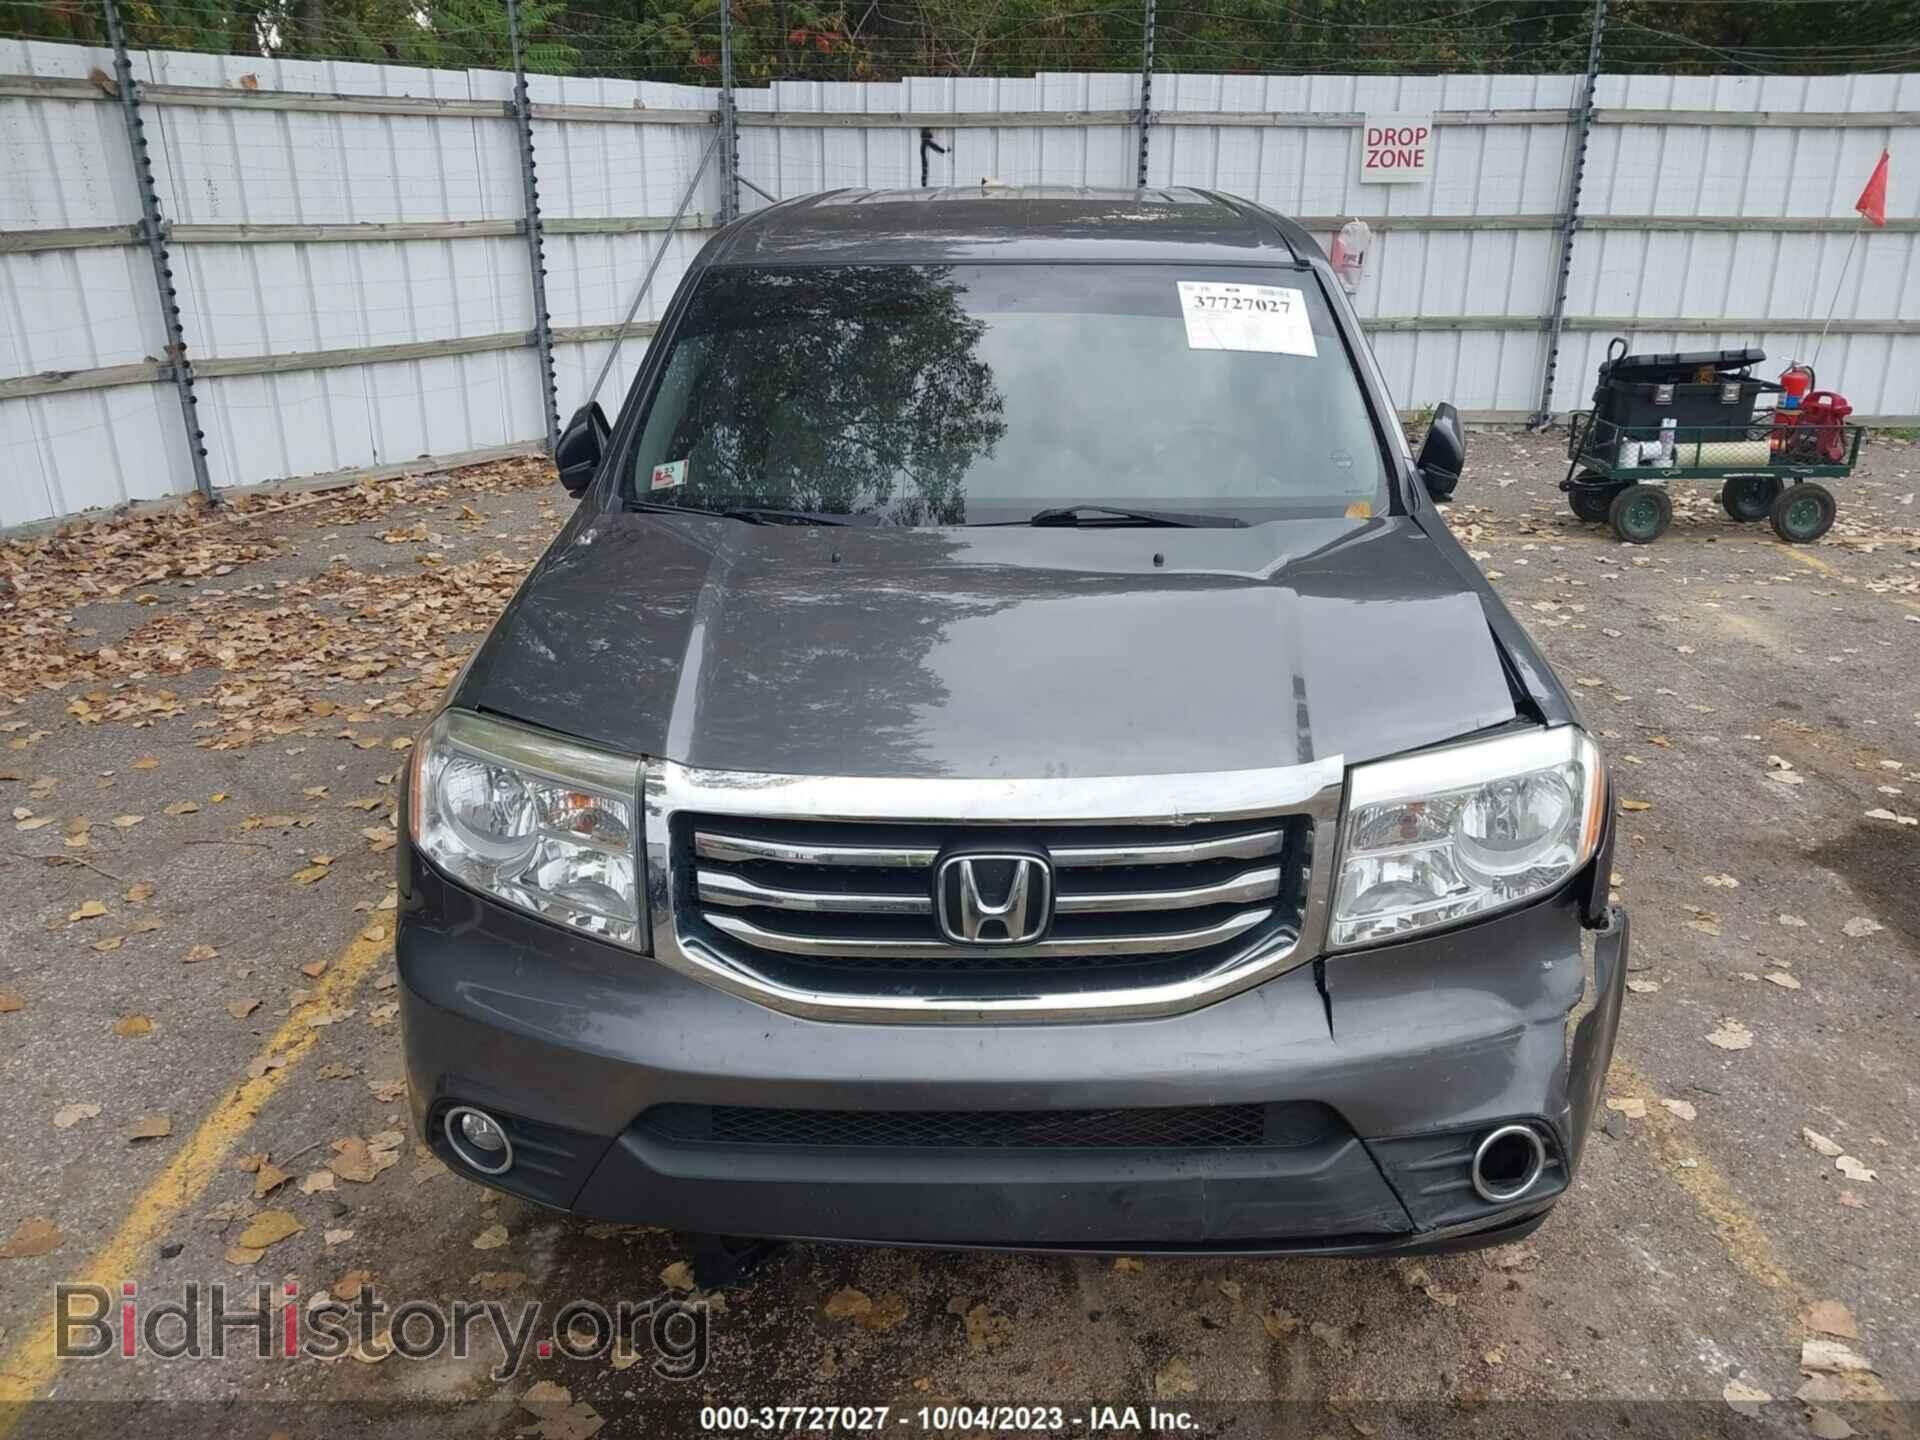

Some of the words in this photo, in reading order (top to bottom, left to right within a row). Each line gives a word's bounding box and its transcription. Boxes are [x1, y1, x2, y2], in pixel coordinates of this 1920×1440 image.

[1367, 127, 1428, 146] DROP
[1366, 149, 1425, 168] ZONE
[1193, 295, 1291, 314] 37727027
